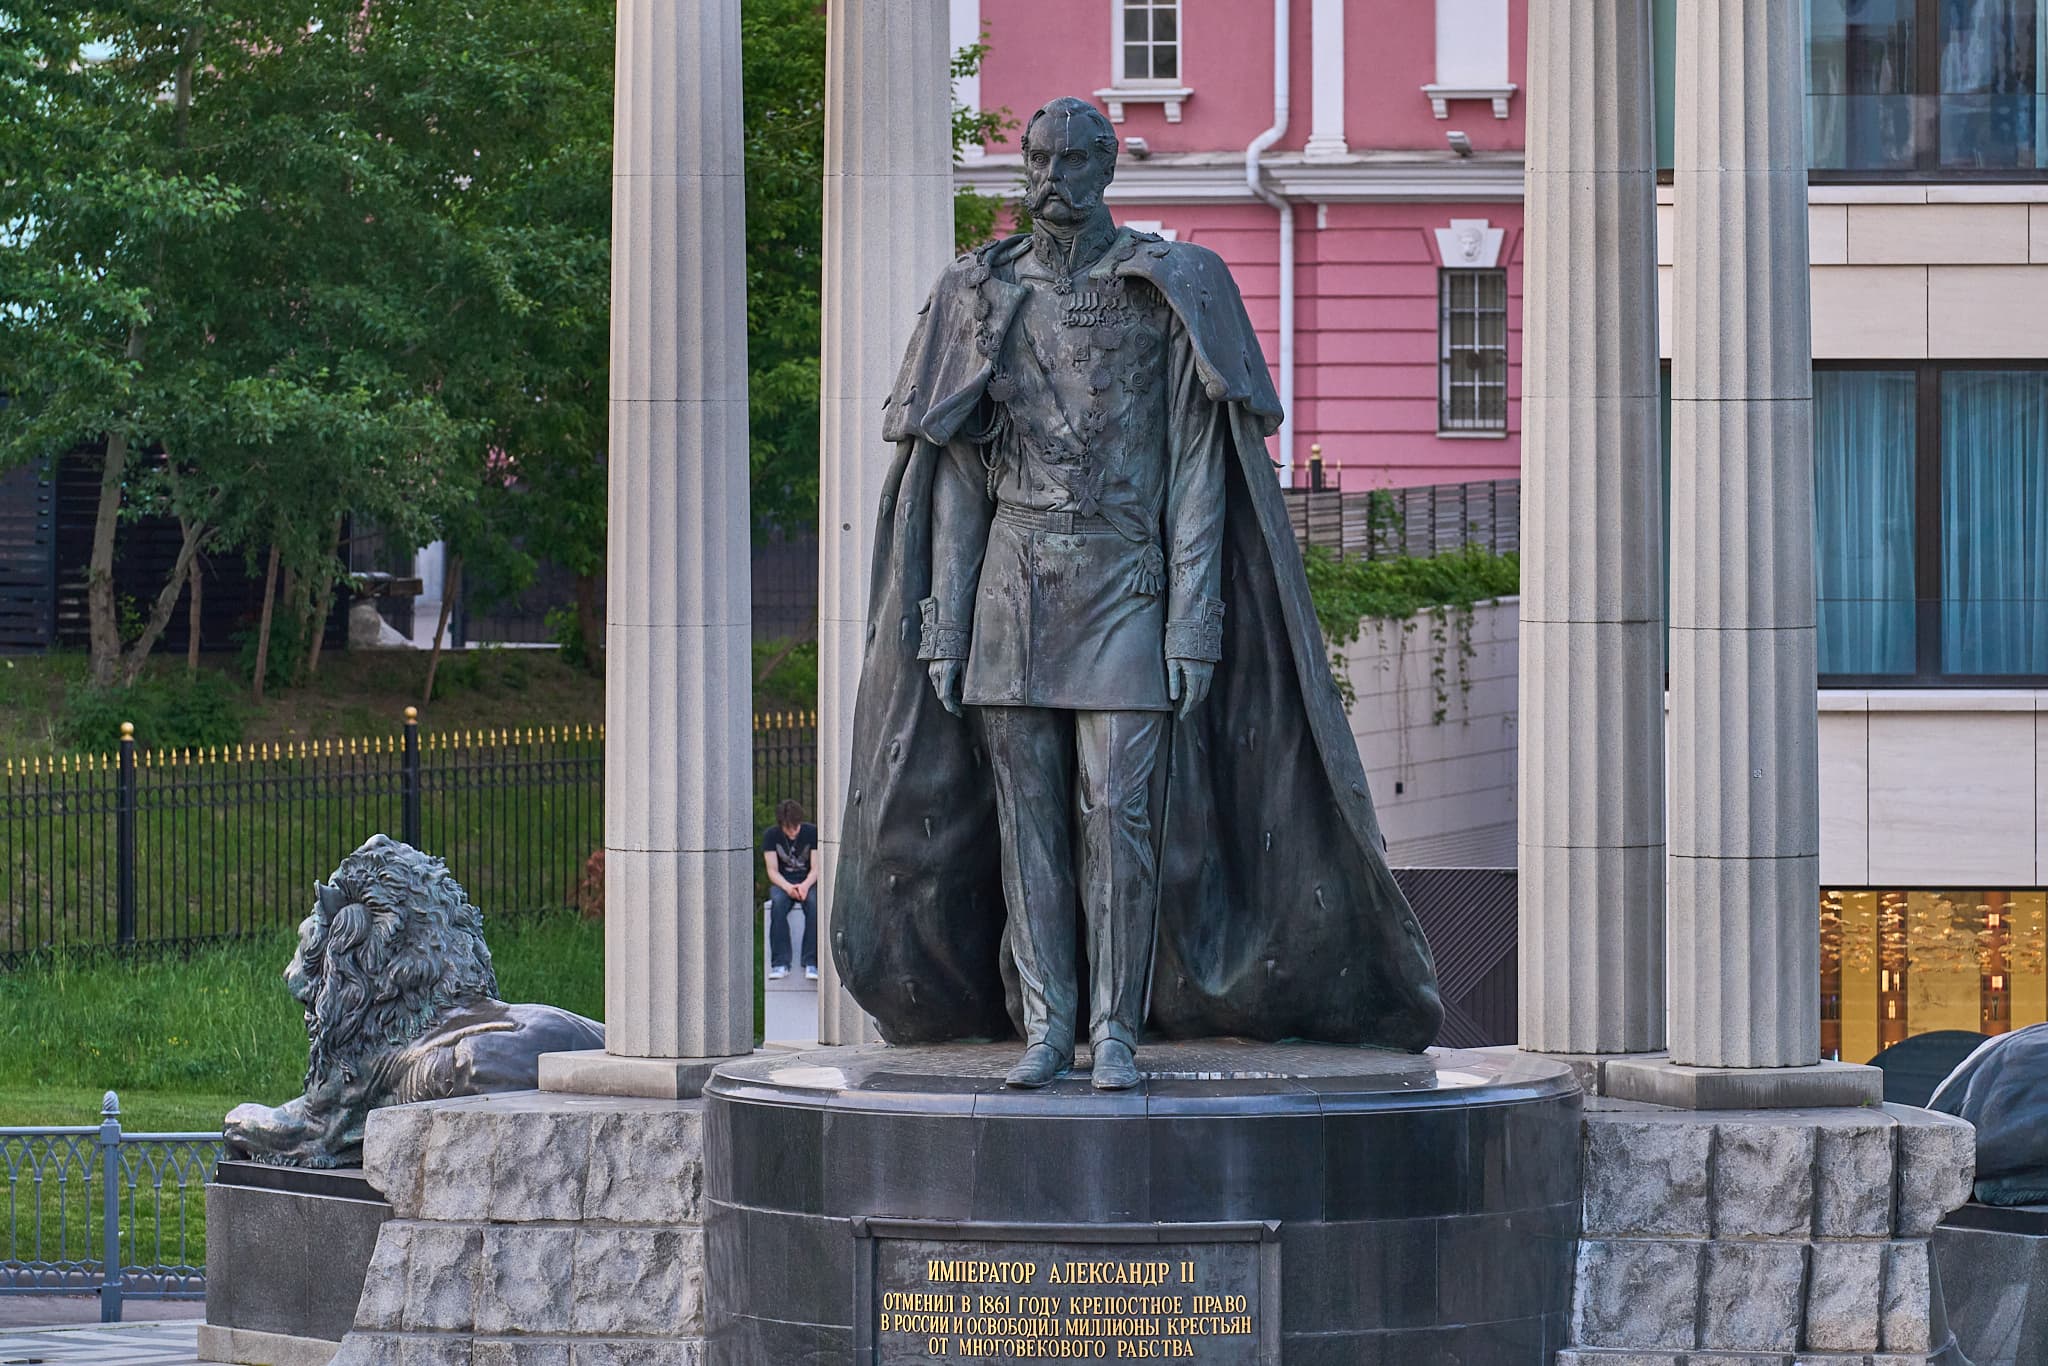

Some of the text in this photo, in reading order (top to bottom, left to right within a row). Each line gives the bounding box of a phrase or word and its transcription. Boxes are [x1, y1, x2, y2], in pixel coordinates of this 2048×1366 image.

[926, 1260, 1036, 1284] ИМПЕРАТОР
[1049, 1262, 1170, 1287] АЛЕКСАНДР
[883, 1292, 1247, 1318] ОТМЕНИЛ В 1861 ГОДУ КРЕПОСТНОЕ ПРАВО
[880, 1313, 1252, 1339] В РОССИИ И ОСВОБОДИЛ МИЛЛИОНЫ КРЕСТЬЯН
[928, 1336, 1194, 1358] ОТ МНОГОВЕКОВОГО РАБСТВА
